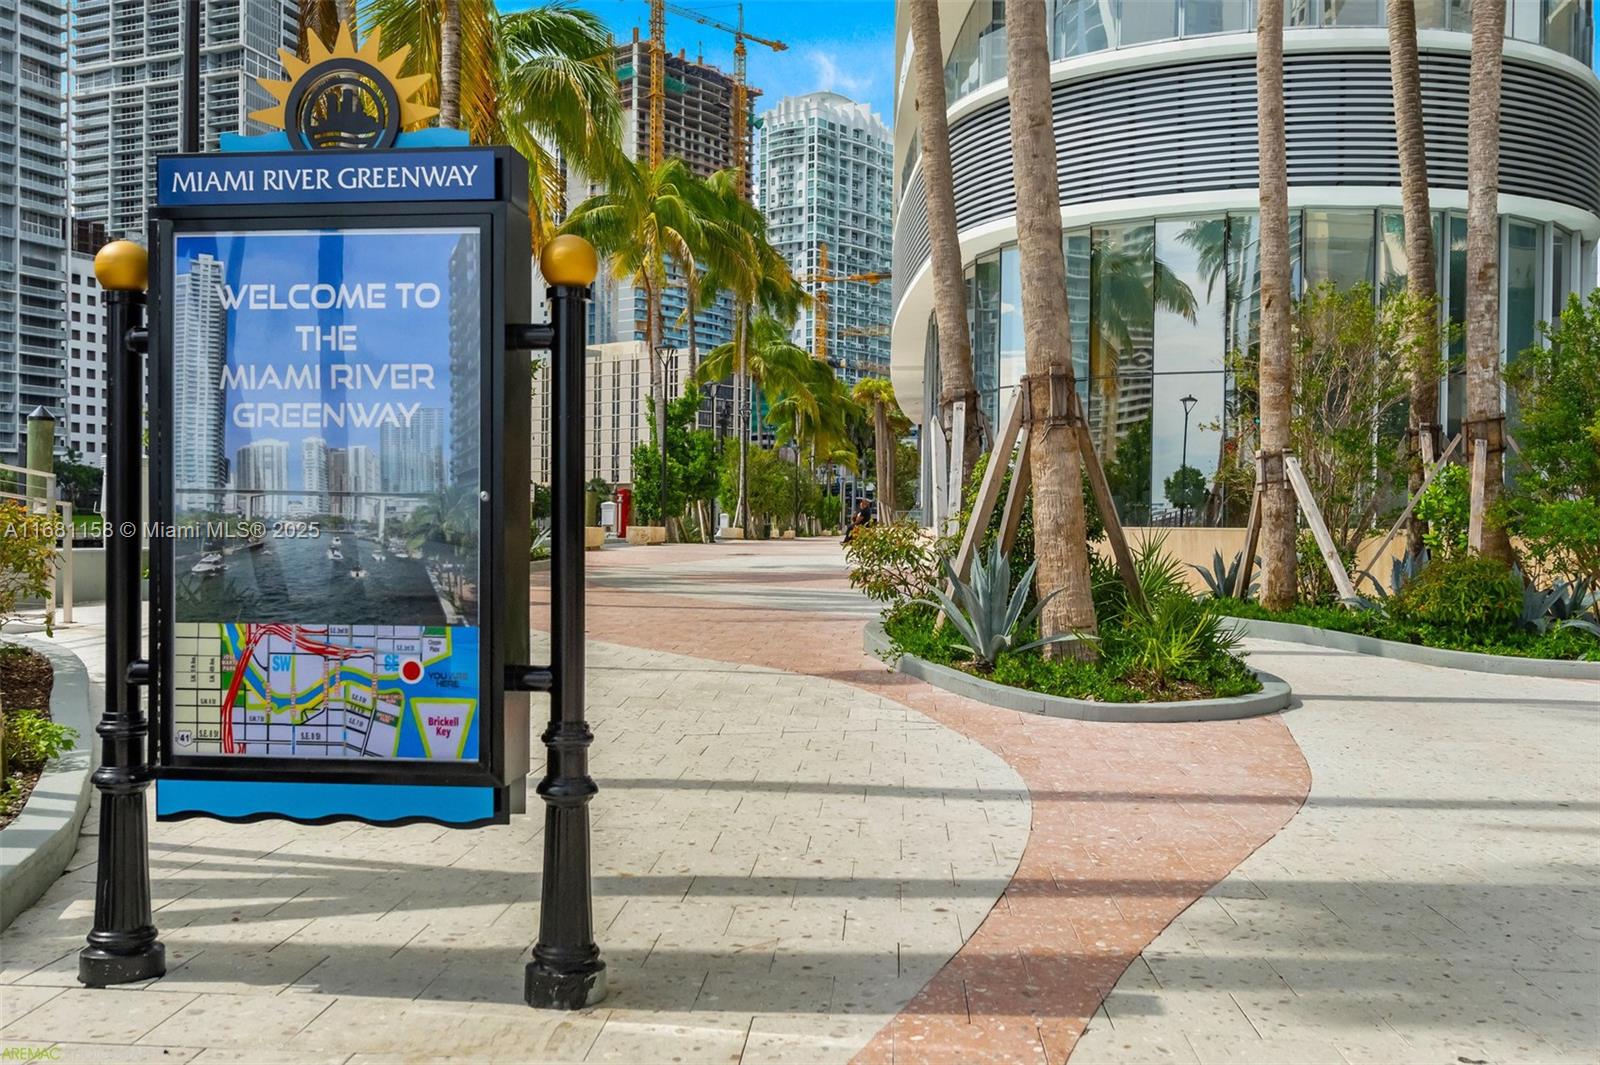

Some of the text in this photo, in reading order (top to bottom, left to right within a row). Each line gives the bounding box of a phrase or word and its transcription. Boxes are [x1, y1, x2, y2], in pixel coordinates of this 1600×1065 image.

[172, 165, 478, 193] MIAMI RIVER GREENWAY
[216, 282, 440, 310] WELCOME TO
[295, 325, 357, 351] THE
[219, 363, 435, 390] MIAMI RIVER
[232, 402, 421, 429] GREENWAY
[272, 655, 291, 672] SW
[384, 654, 399, 671] SE
[428, 672, 448, 680] YOU
[428, 716, 460, 727] Brickell
[180, 734, 190, 742] 41
[436, 727, 451, 739] Key
